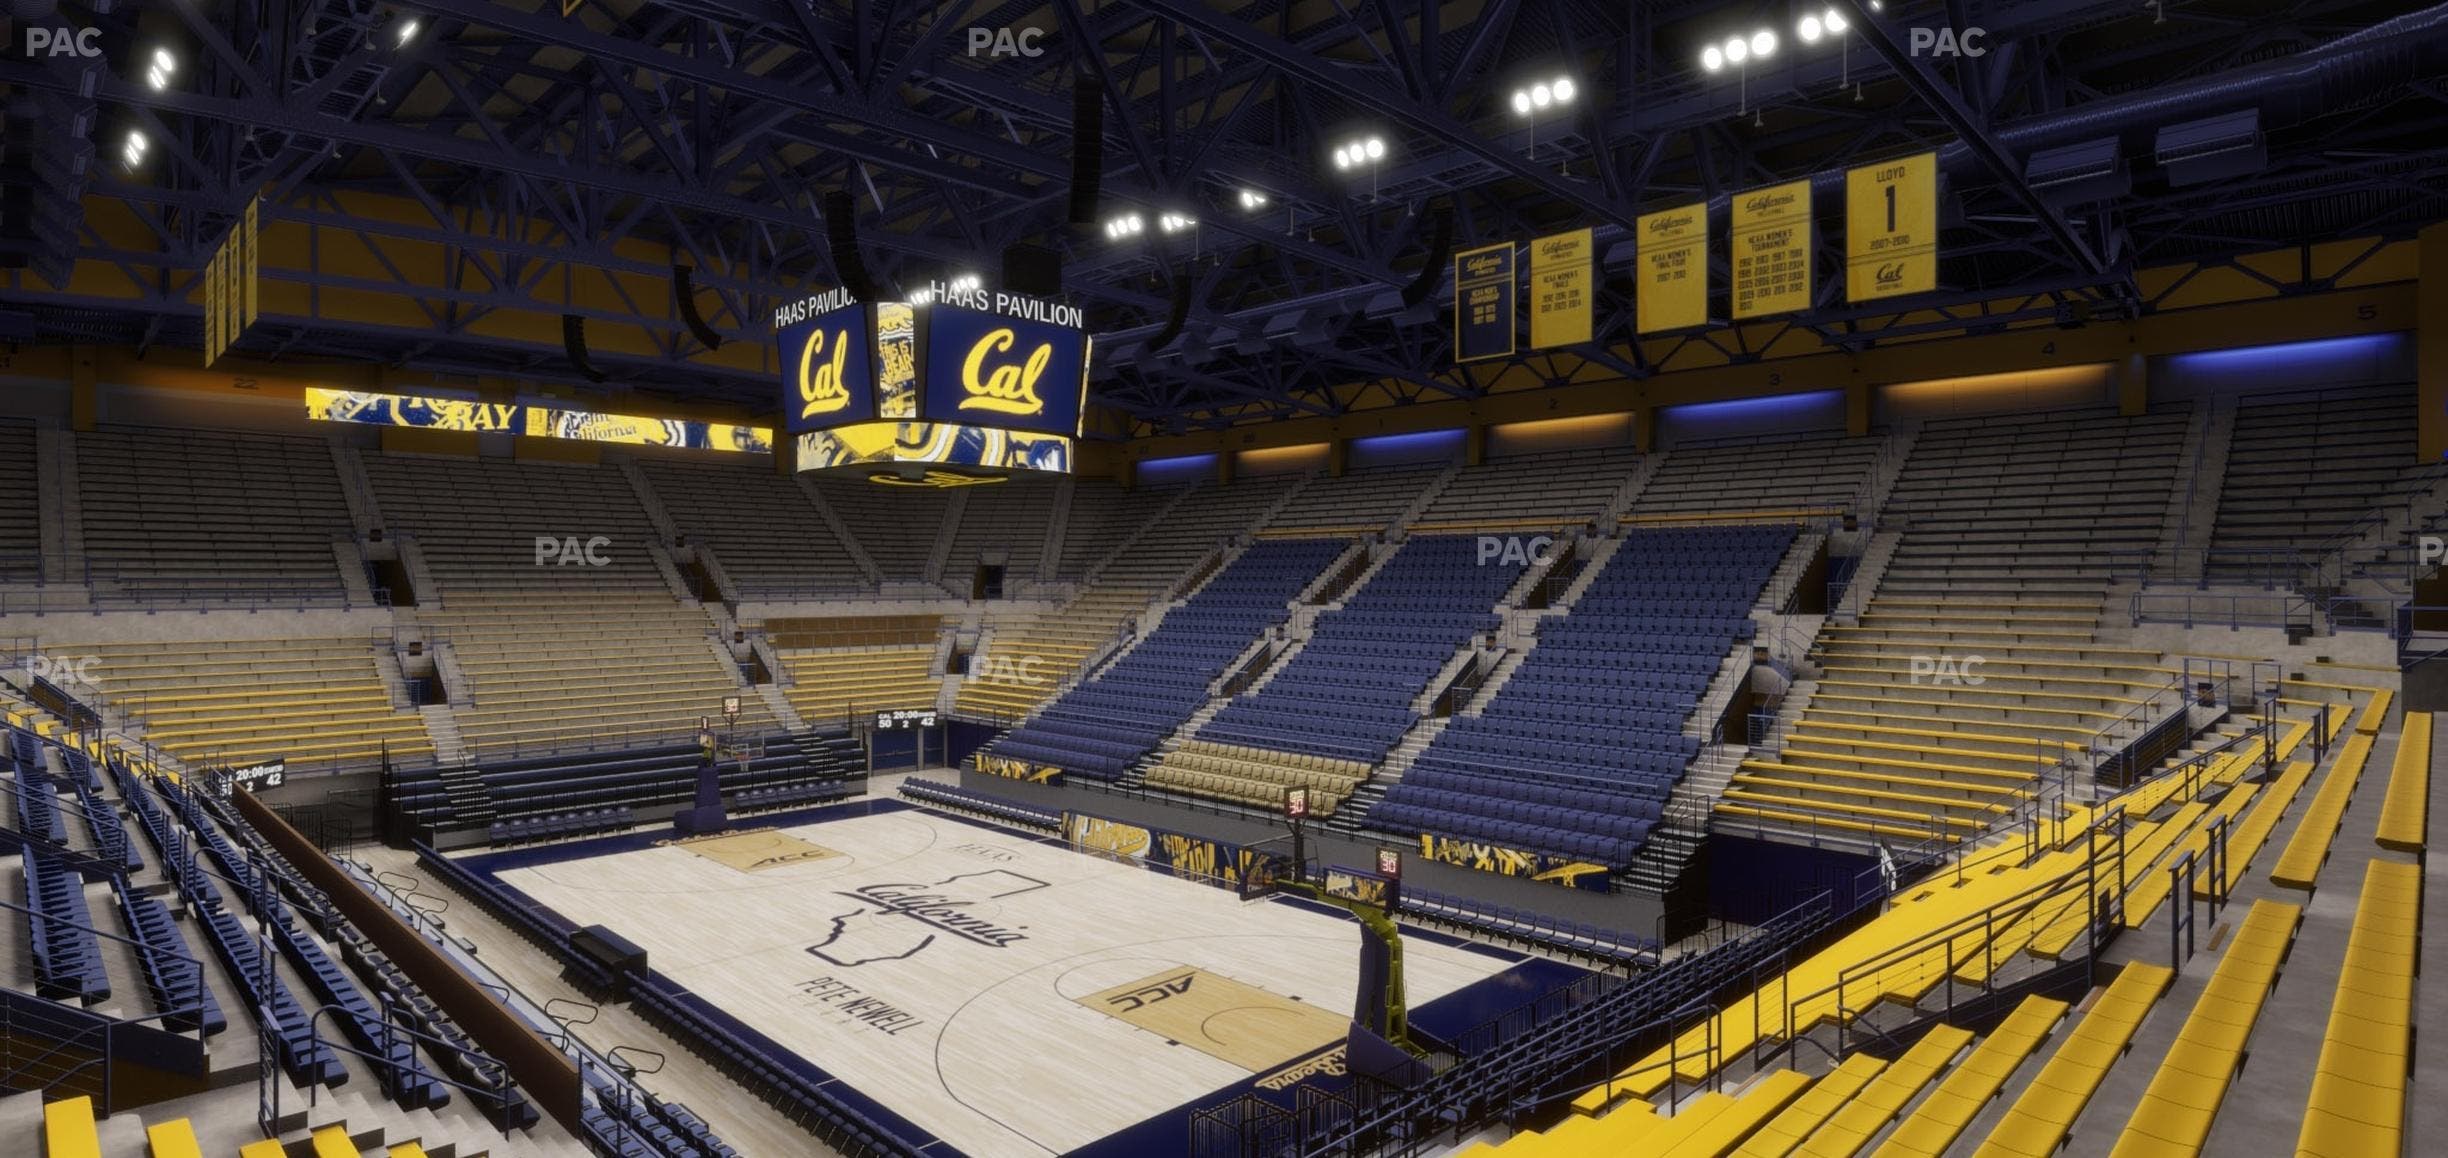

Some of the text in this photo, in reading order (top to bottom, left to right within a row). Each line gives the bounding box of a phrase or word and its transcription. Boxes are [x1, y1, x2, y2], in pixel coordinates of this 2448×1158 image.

[1876, 166, 1906, 183] LLOYD
[1745, 194, 1796, 214] California
[1885, 184, 1896, 233] 1
[1875, 262, 1905, 284] Cal
[775, 285, 858, 329] HAAS PAVILIO
[931, 280, 1083, 329] HAAS PAVILION
[800, 328, 851, 421] Cal
[958, 328, 1053, 416] Cal
[878, 717, 935, 729] 50 2 42
[235, 766, 264, 781] 20:00
[246, 781, 254, 792] 2
[266, 773, 282, 786] 42
[1382, 859, 1397, 873] 30
[832, 883, 1030, 948] California
[795, 976, 862, 1002] PETE
[835, 996, 925, 1036] NEWELL
[1106, 975, 1195, 1013] ACC
